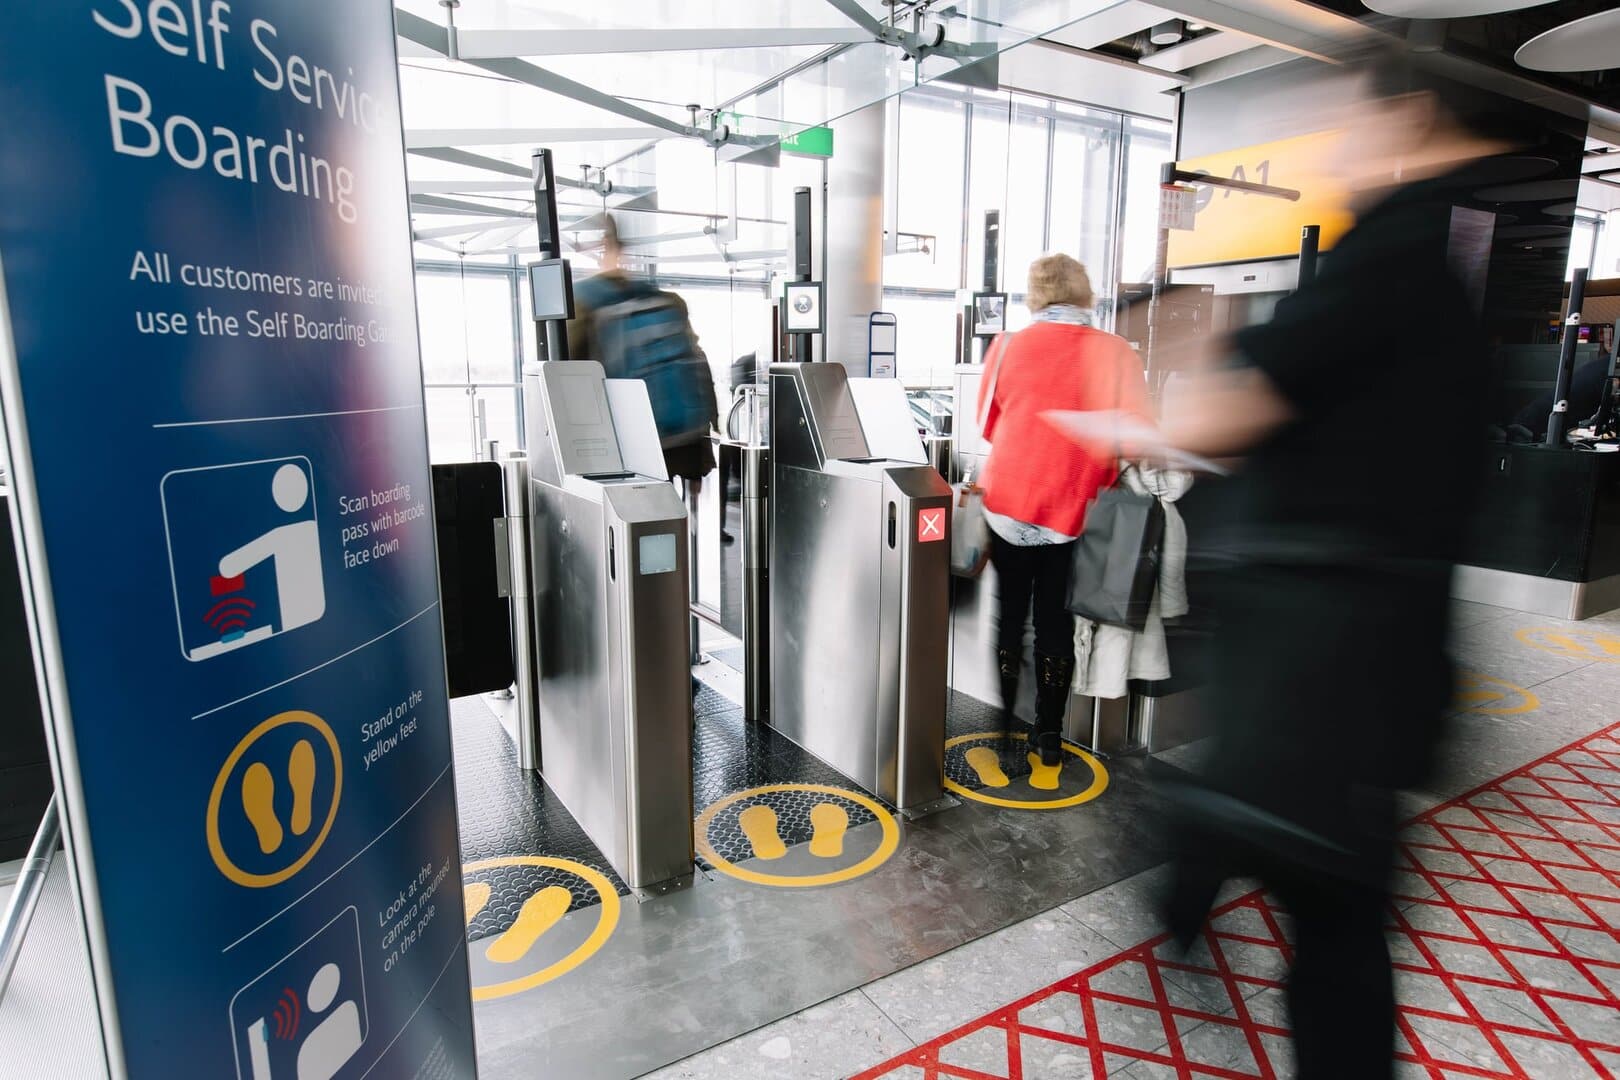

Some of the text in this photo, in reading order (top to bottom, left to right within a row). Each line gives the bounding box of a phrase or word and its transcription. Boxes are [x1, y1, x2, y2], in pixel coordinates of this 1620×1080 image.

[250, 18, 388, 134] Servic
[104, 73, 357, 224] Boarding
[778, 132, 800, 146] xit
[1223, 159, 1270, 199] A1
[130, 251, 171, 283] All
[180, 263, 303, 296] customers
[308, 279, 334, 299] are
[136, 311, 188, 335] use
[196, 307, 239, 336] the
[246, 310, 288, 338] Self
[294, 314, 366, 347] Boarding
[339, 482, 411, 515] Scan boarding
[342, 502, 425, 547] pass with barcode
[344, 537, 399, 568] face down
[361, 689, 423, 742] Stand on the
[364, 717, 418, 772] yellow feet
[379, 863, 432, 928] Look at the
[382, 856, 450, 949] camera mounted
[384, 904, 436, 972] on the pole
